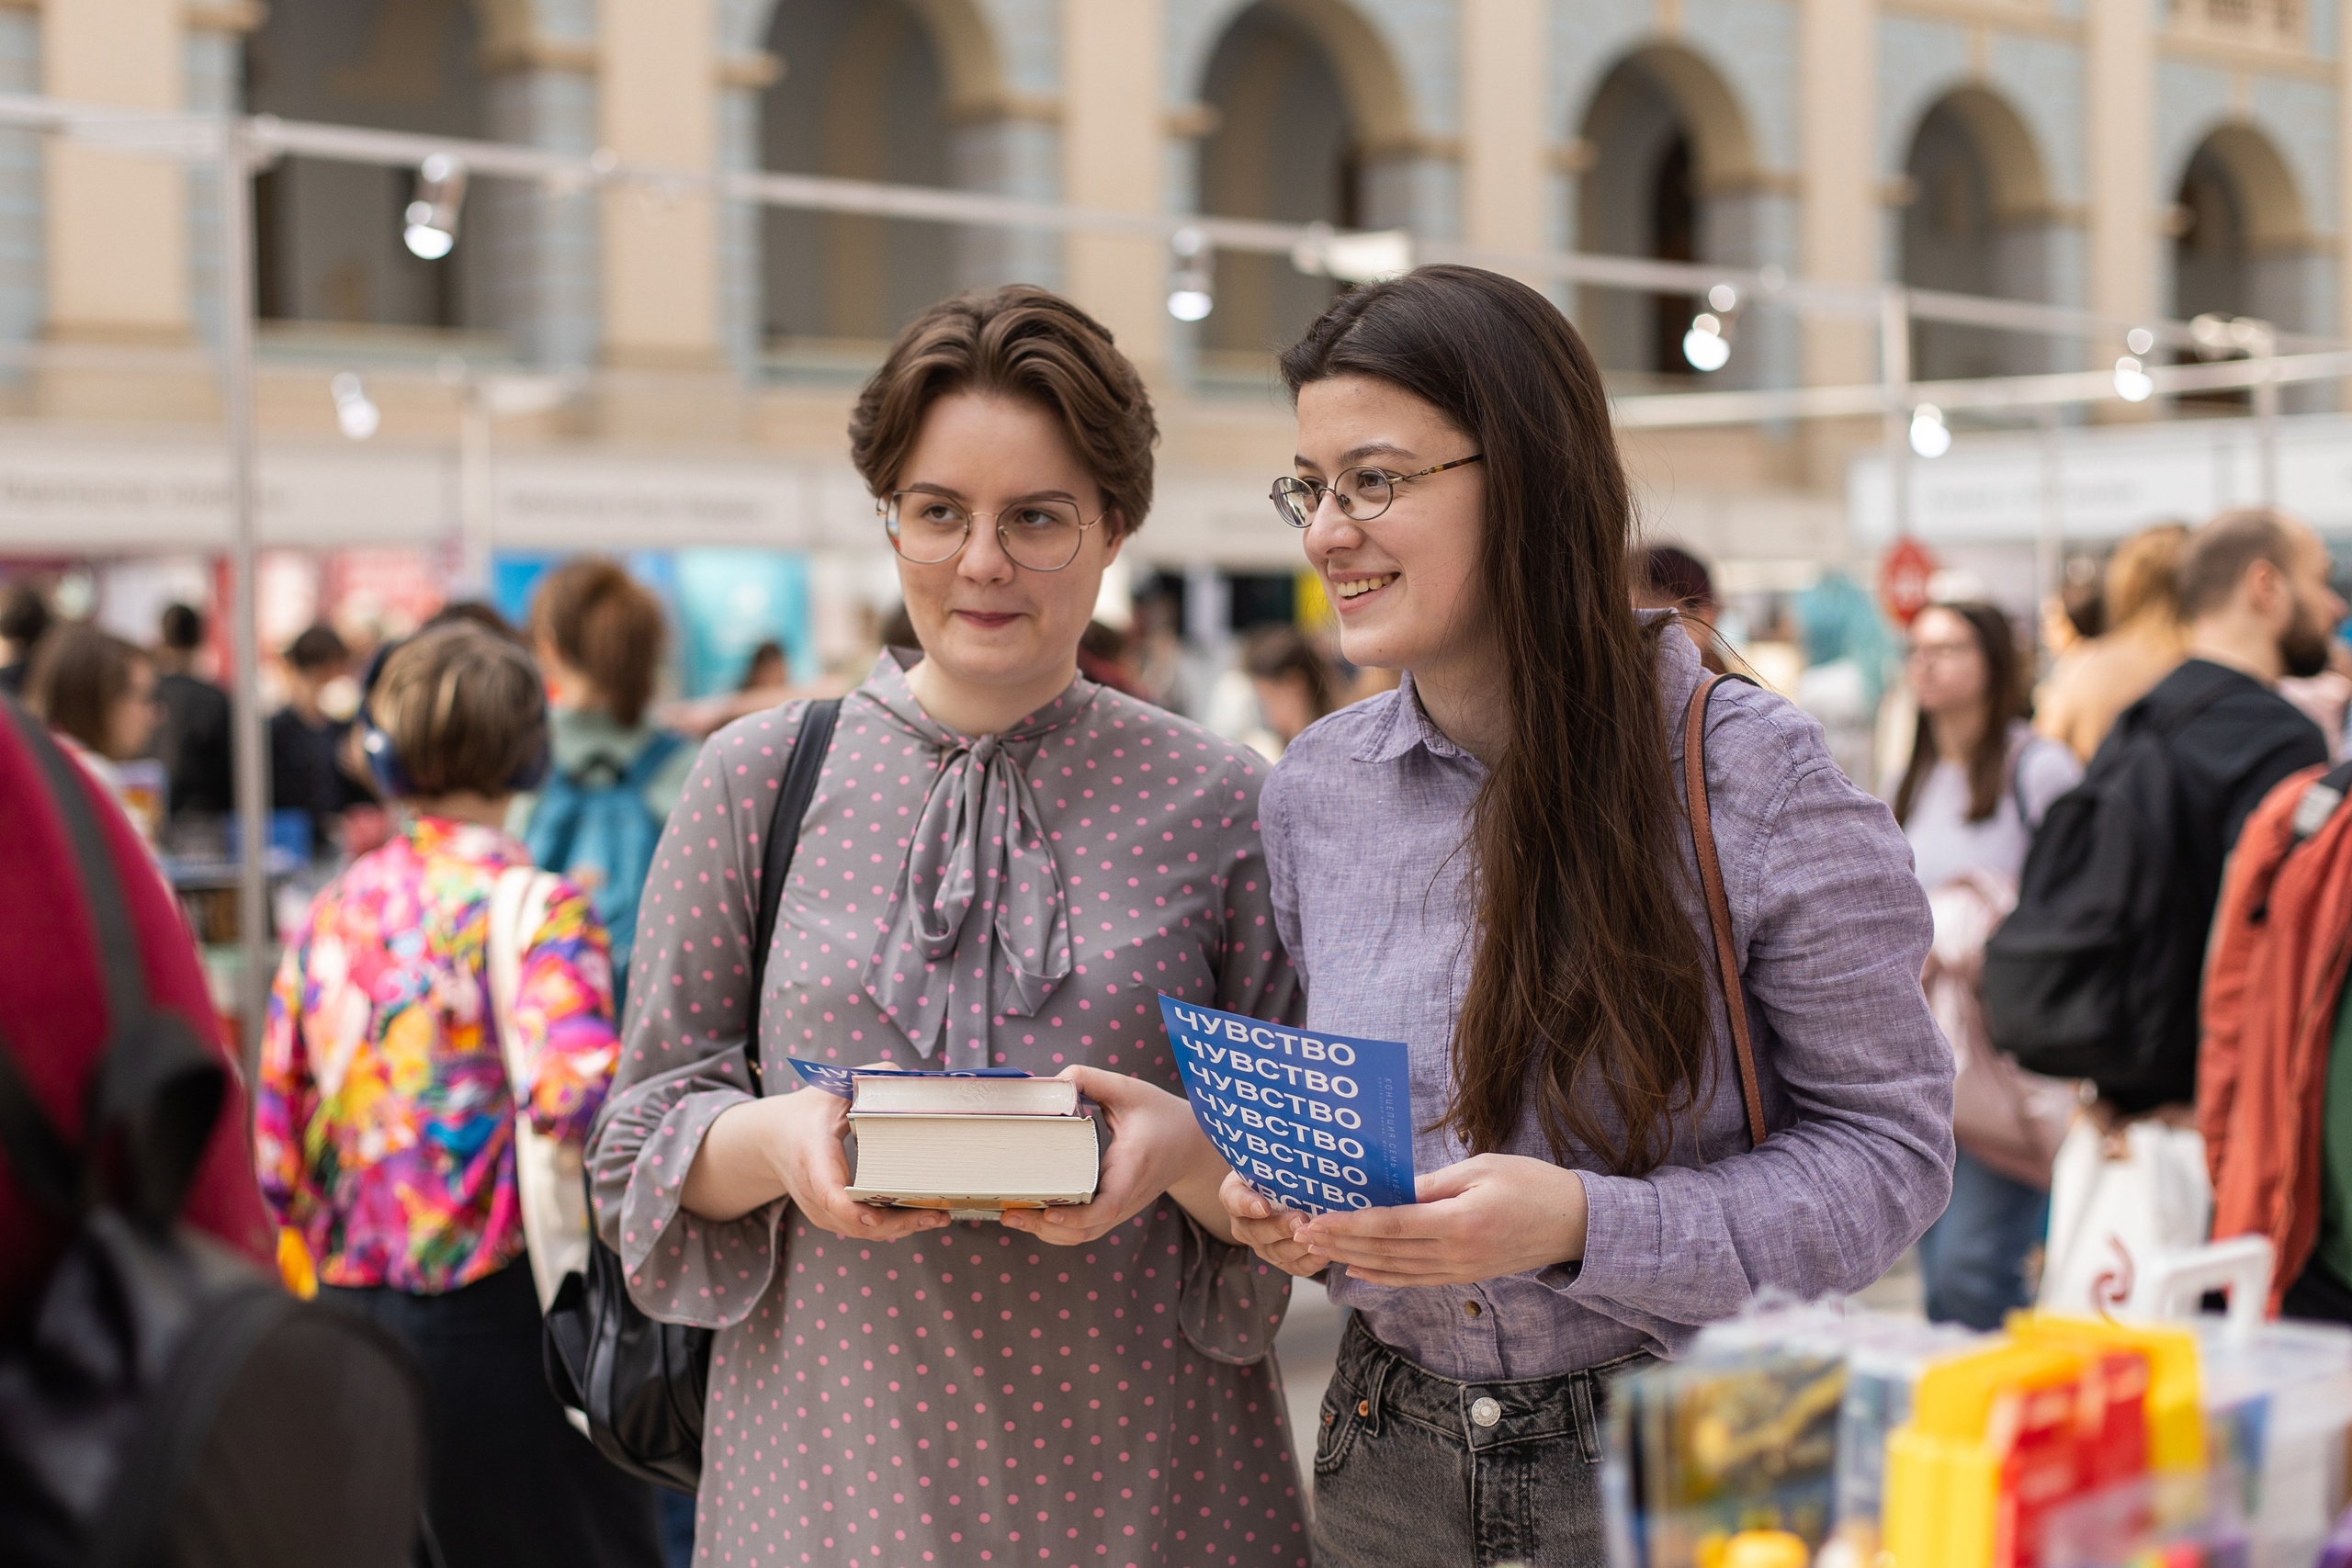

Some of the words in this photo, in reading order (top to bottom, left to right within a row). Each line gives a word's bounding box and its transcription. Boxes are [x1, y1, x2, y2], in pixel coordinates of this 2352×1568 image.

[1174, 1006, 1356, 1066] ЧУВСТВО
[1181, 1034, 1359, 1099] ЧУВСТВО
[1188, 1061, 1362, 1130] ЧУВСТВО
[1195, 1086, 1364, 1159] ЧУВСТВО
[1385, 1077, 1396, 1138] КОНЦЕПЦИЯ
[1203, 1111, 1368, 1186] ЧУВСТВО
[1210, 1134, 1373, 1210] ЧУВСТВО
[1388, 1143, 1397, 1168] СЕМЬ
